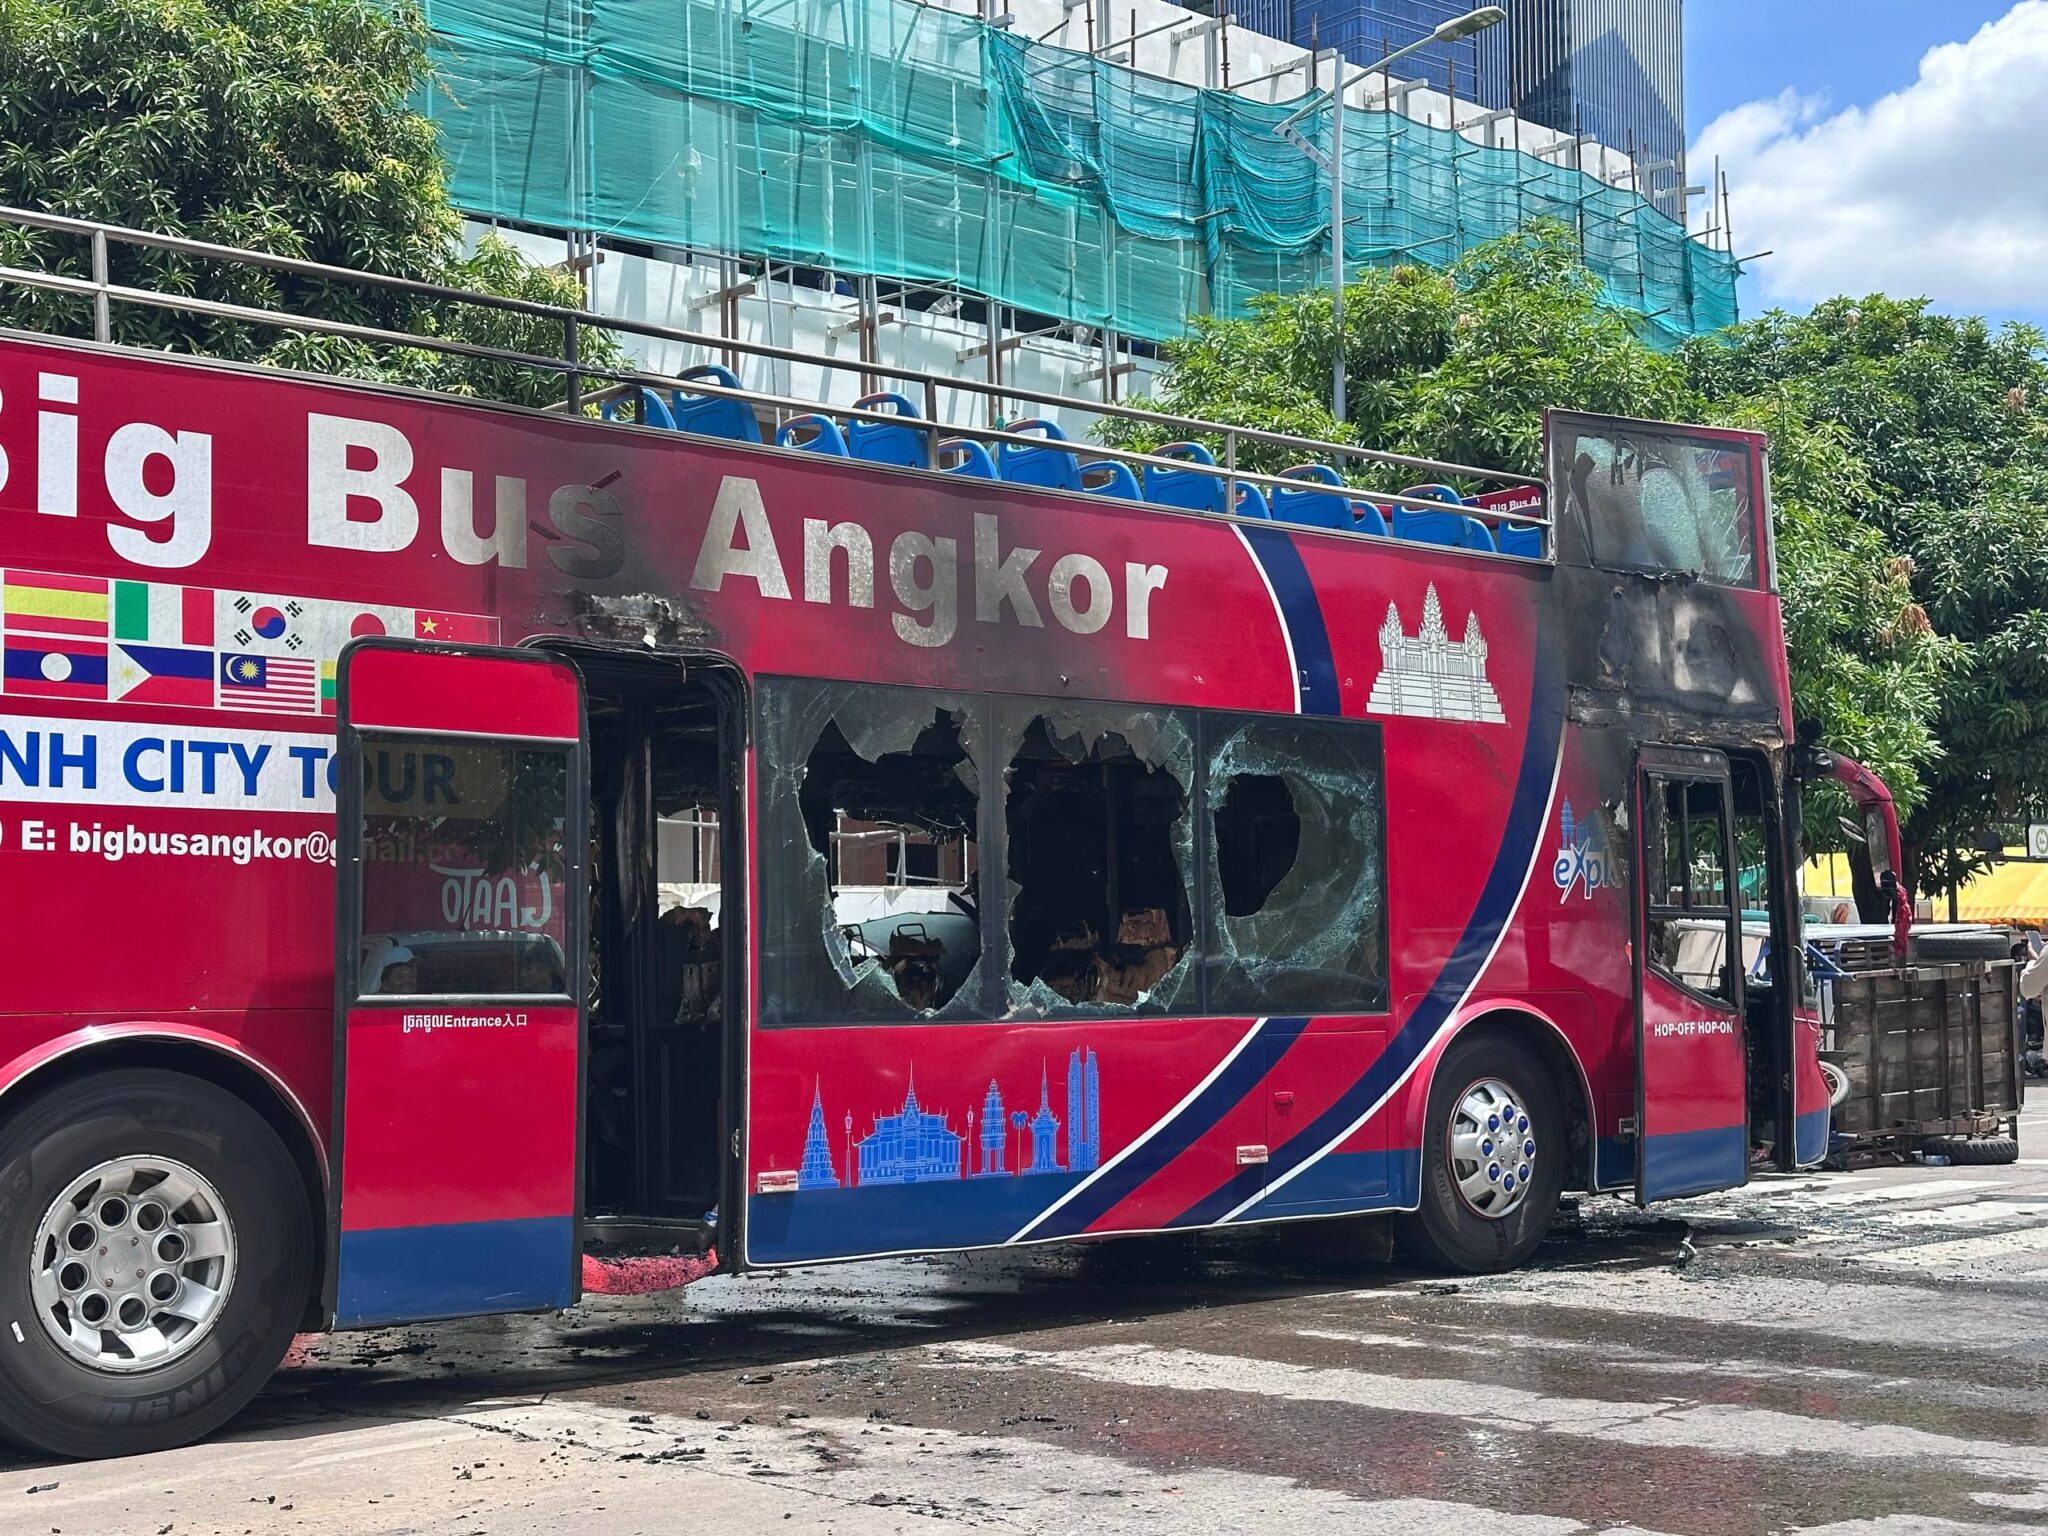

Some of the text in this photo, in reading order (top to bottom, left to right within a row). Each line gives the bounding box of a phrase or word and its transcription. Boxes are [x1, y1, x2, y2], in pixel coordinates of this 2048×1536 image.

[0, 371, 1169, 648] ig Bus Angkor
[1509, 499, 1528, 509] Bus
[122, 737, 272, 797] CITY
[21, 820, 55, 851] E:
[444, 1014, 502, 1028] Entrance
[502, 1013, 528, 1028] 入口
[1654, 1020, 1733, 1037] HOP-OFF HOP-ON
